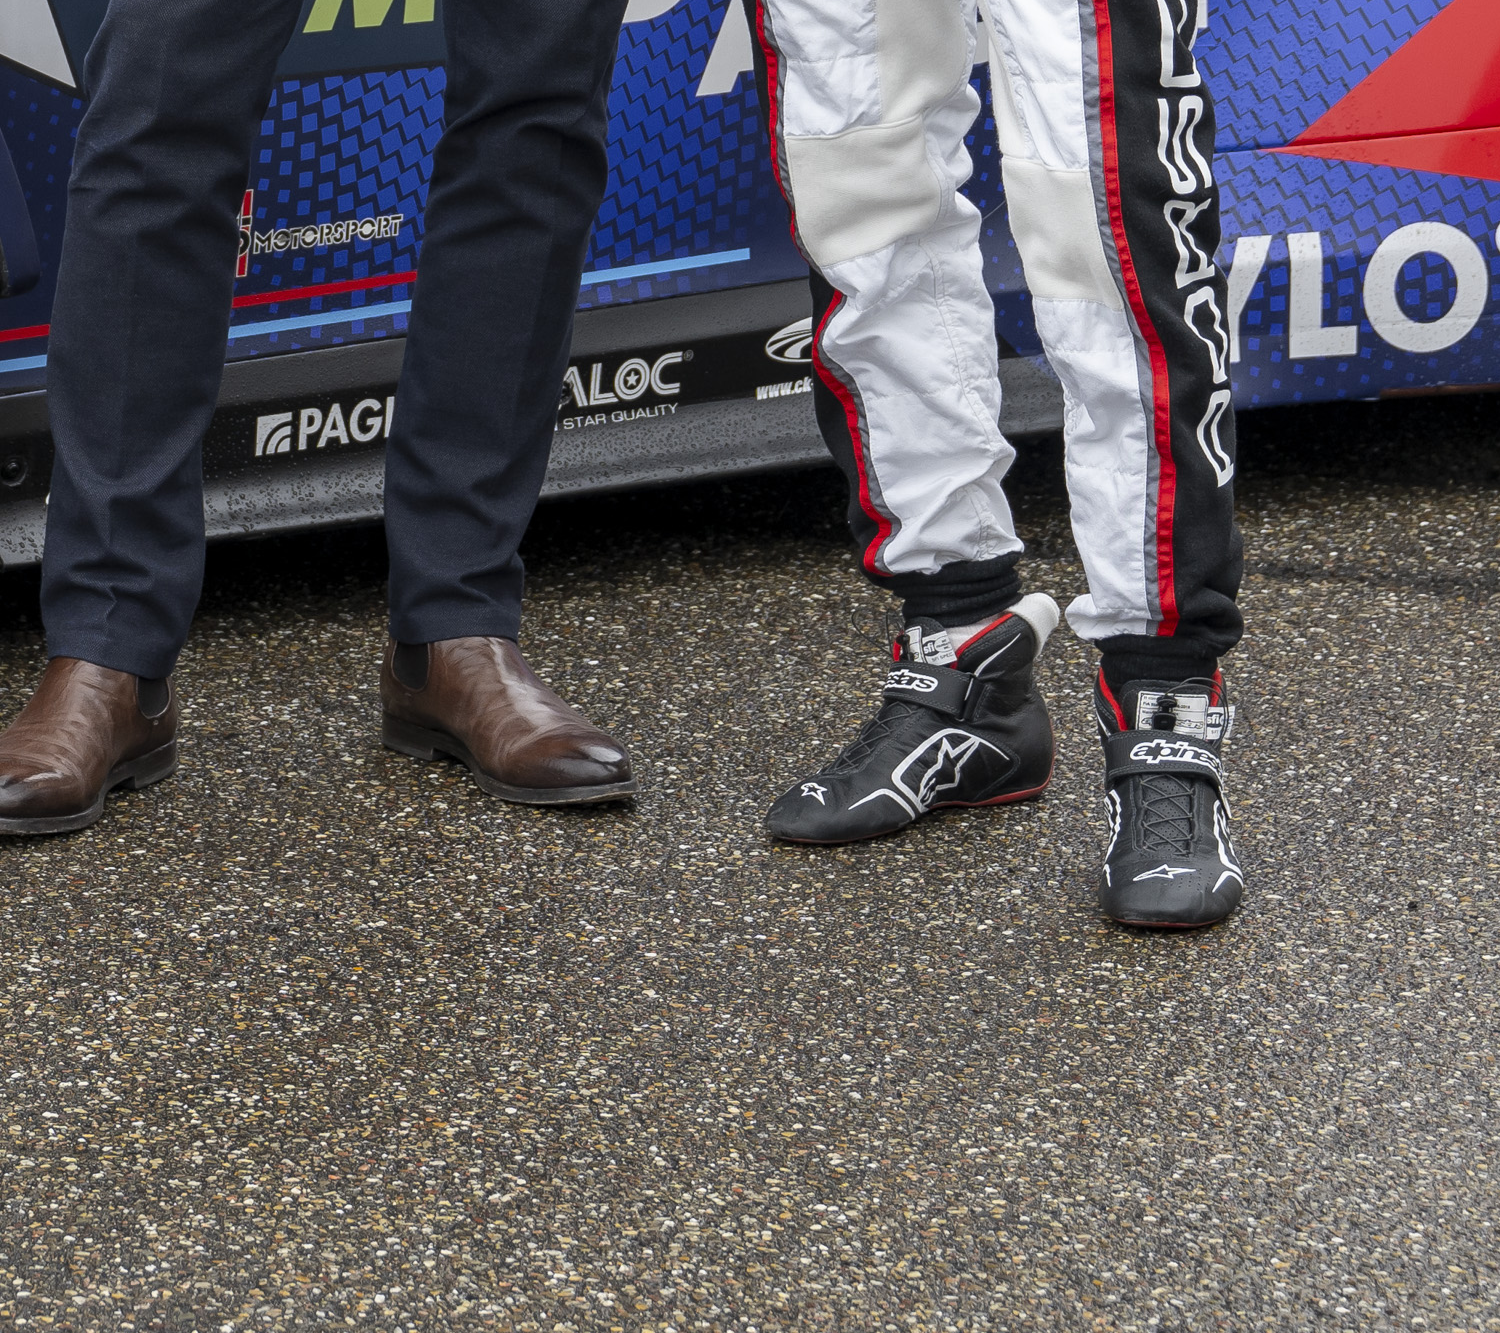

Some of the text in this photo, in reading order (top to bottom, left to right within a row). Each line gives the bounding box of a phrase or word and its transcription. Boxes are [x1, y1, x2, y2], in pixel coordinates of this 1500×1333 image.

[253, 213, 404, 255] MOTORSPORT
[298, 396, 396, 451] PAGI
[562, 402, 679, 431] STAR QUALITY
